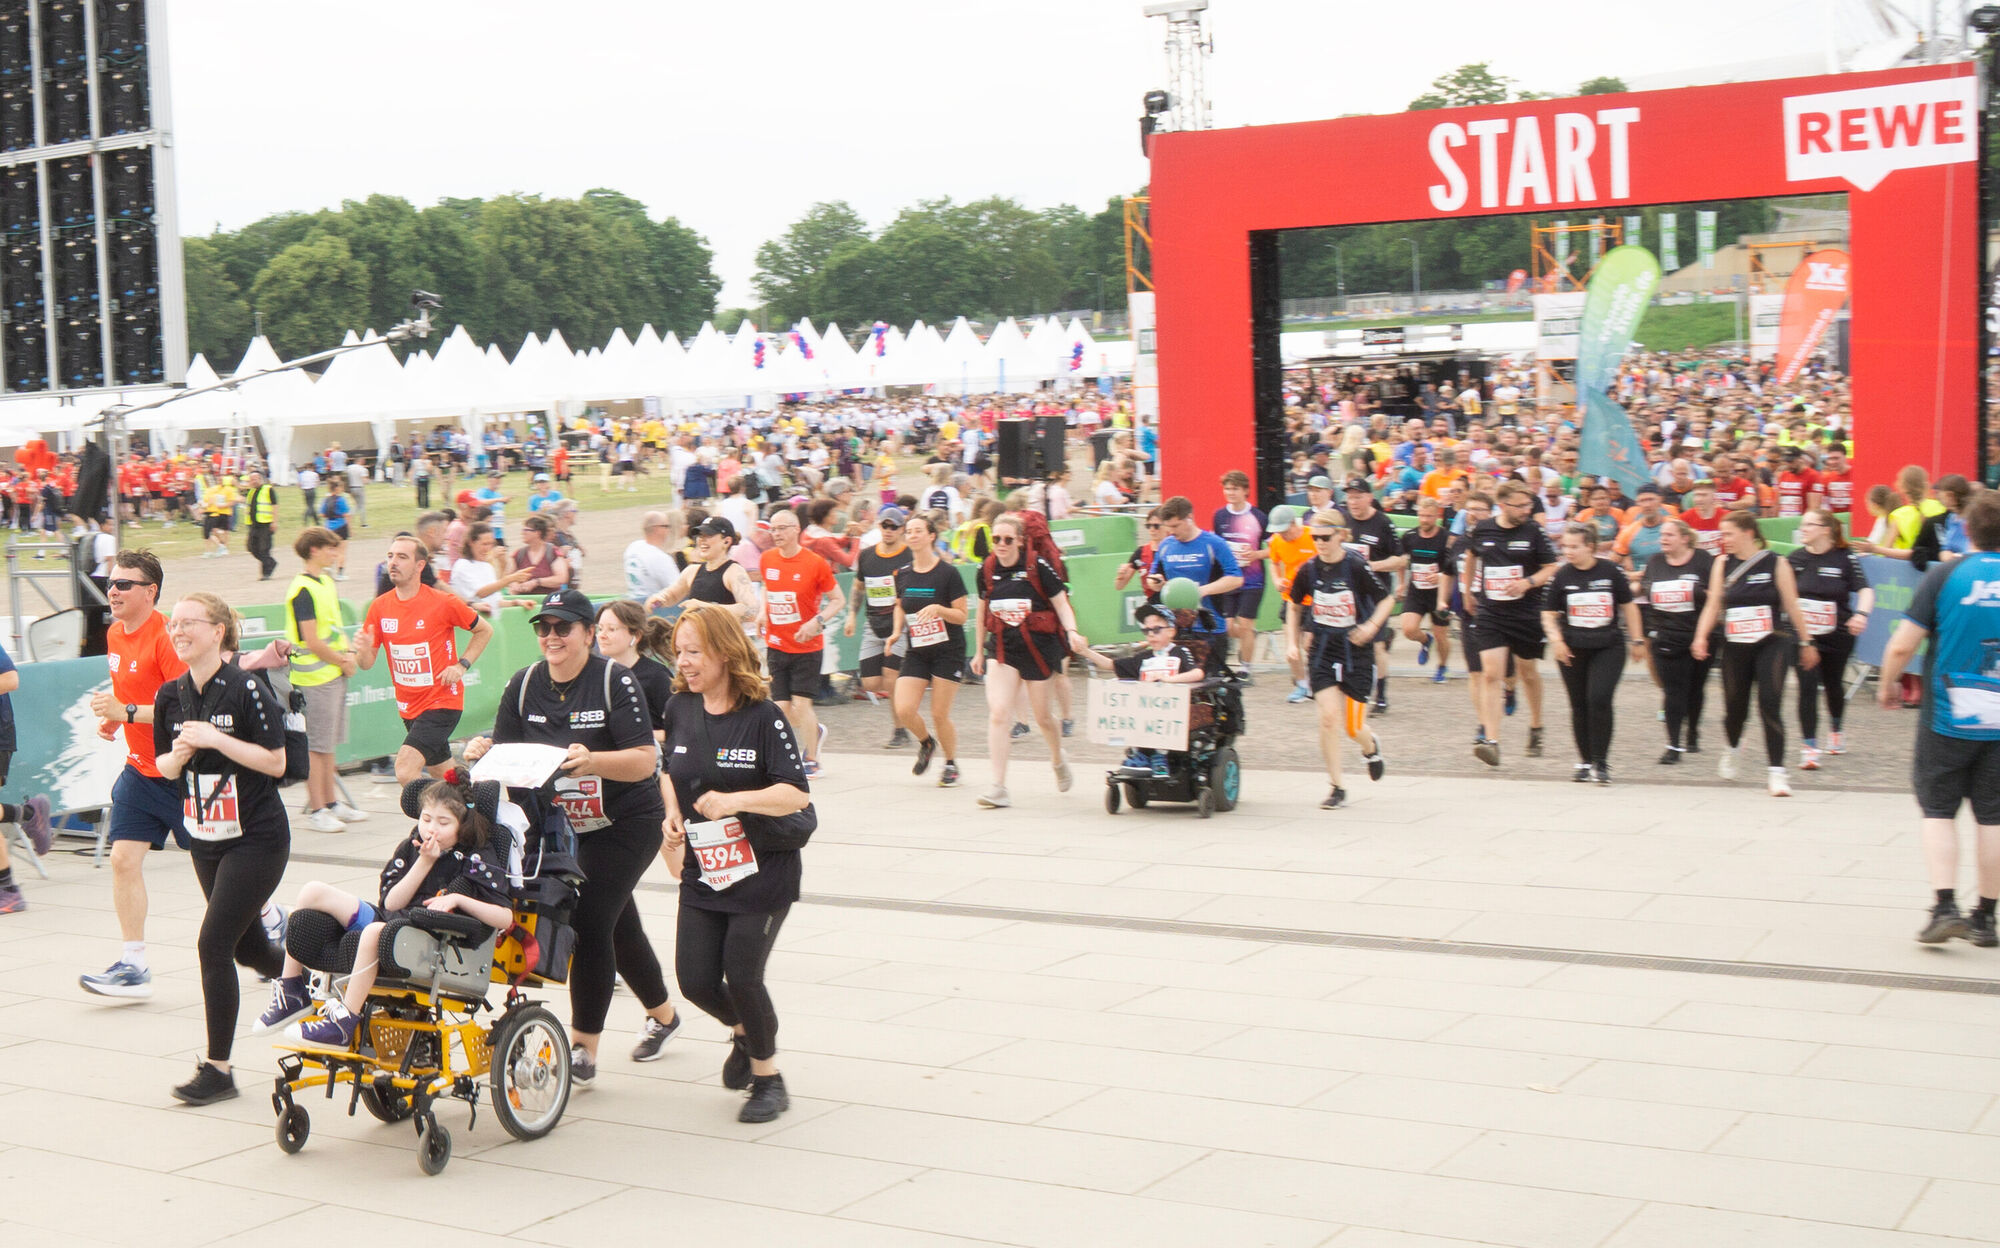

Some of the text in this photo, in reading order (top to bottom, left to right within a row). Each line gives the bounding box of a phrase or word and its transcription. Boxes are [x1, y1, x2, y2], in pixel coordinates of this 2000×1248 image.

[1799, 101, 1965, 155] REWE
[1428, 107, 1640, 211] START
[382, 620, 397, 633] DB
[394, 659, 422, 674] 11191
[1102, 692, 1130, 707] IST
[580, 710, 605, 722] SEB
[1098, 715, 1136, 730] MEHR
[728, 748, 757, 762] SEB
[707, 873, 732, 885] REWE
